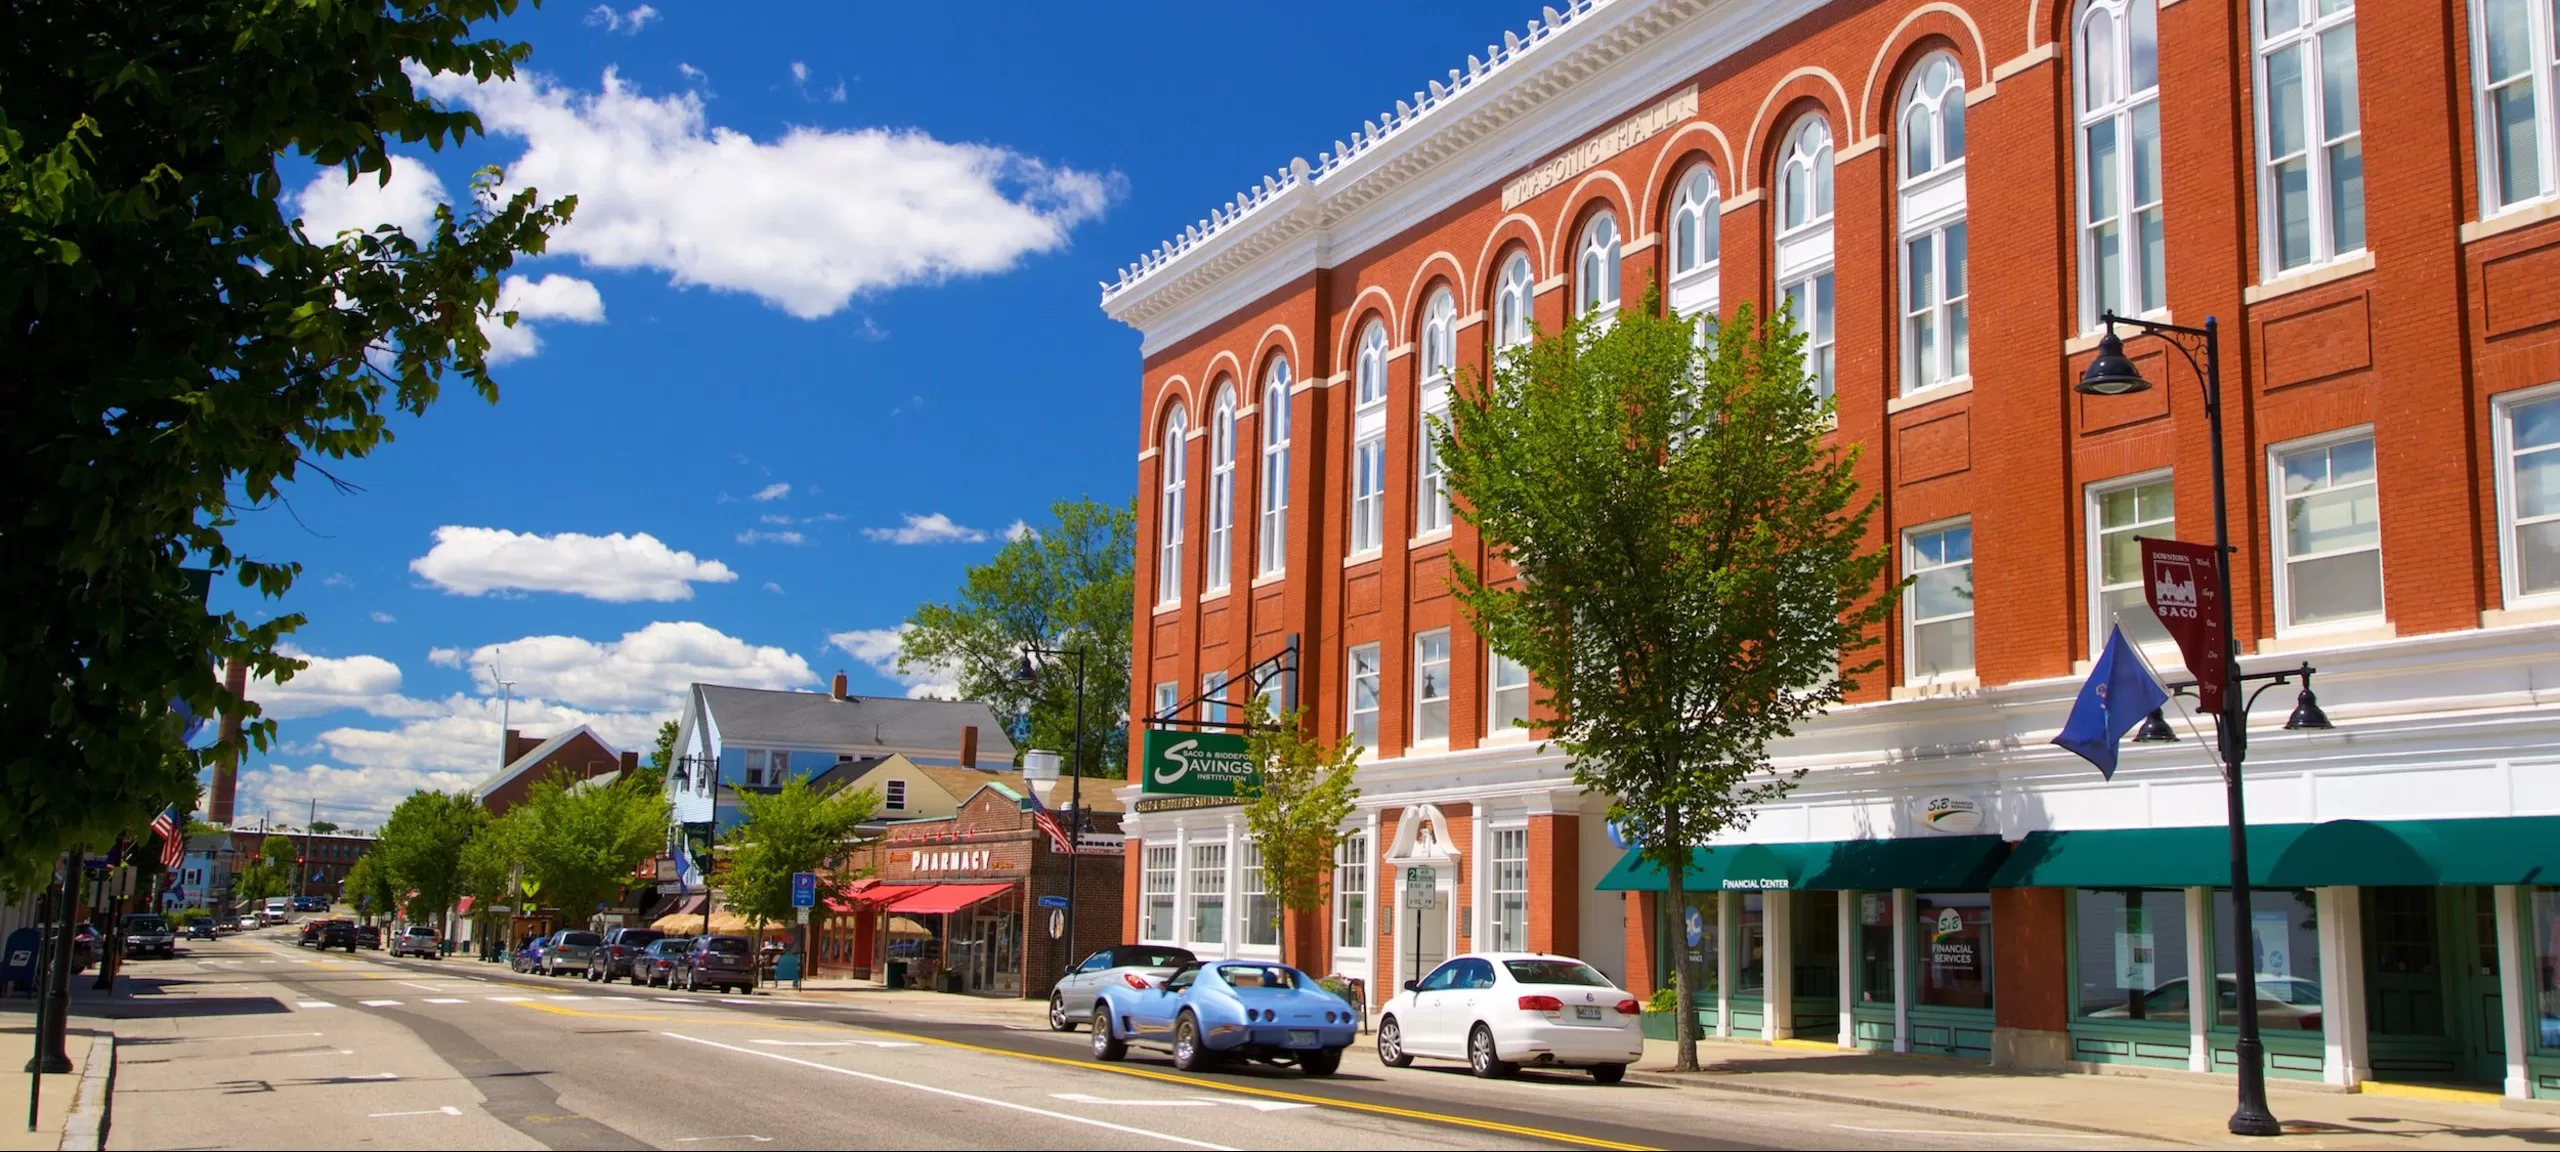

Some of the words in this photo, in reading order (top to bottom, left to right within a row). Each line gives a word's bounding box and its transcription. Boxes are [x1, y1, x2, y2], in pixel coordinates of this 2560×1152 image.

[1517, 140, 1600, 201] MASONIC
[2158, 606, 2197, 619] SACO
[1183, 750, 1204, 758] SACO
[1214, 752, 1251, 760] BIDDEFO
[1154, 739, 1253, 784] SAVINGS
[1197, 773, 1247, 782] INSTITUTION
[911, 850, 990, 872] PHARMACY
[1409, 869, 1416, 880] 2
[1723, 879, 1760, 889] FINANCIAL
[1760, 878, 1789, 888] CENTER
[1932, 944, 1973, 954] FINANCIAL
[1934, 954, 1971, 963] SERVICES
